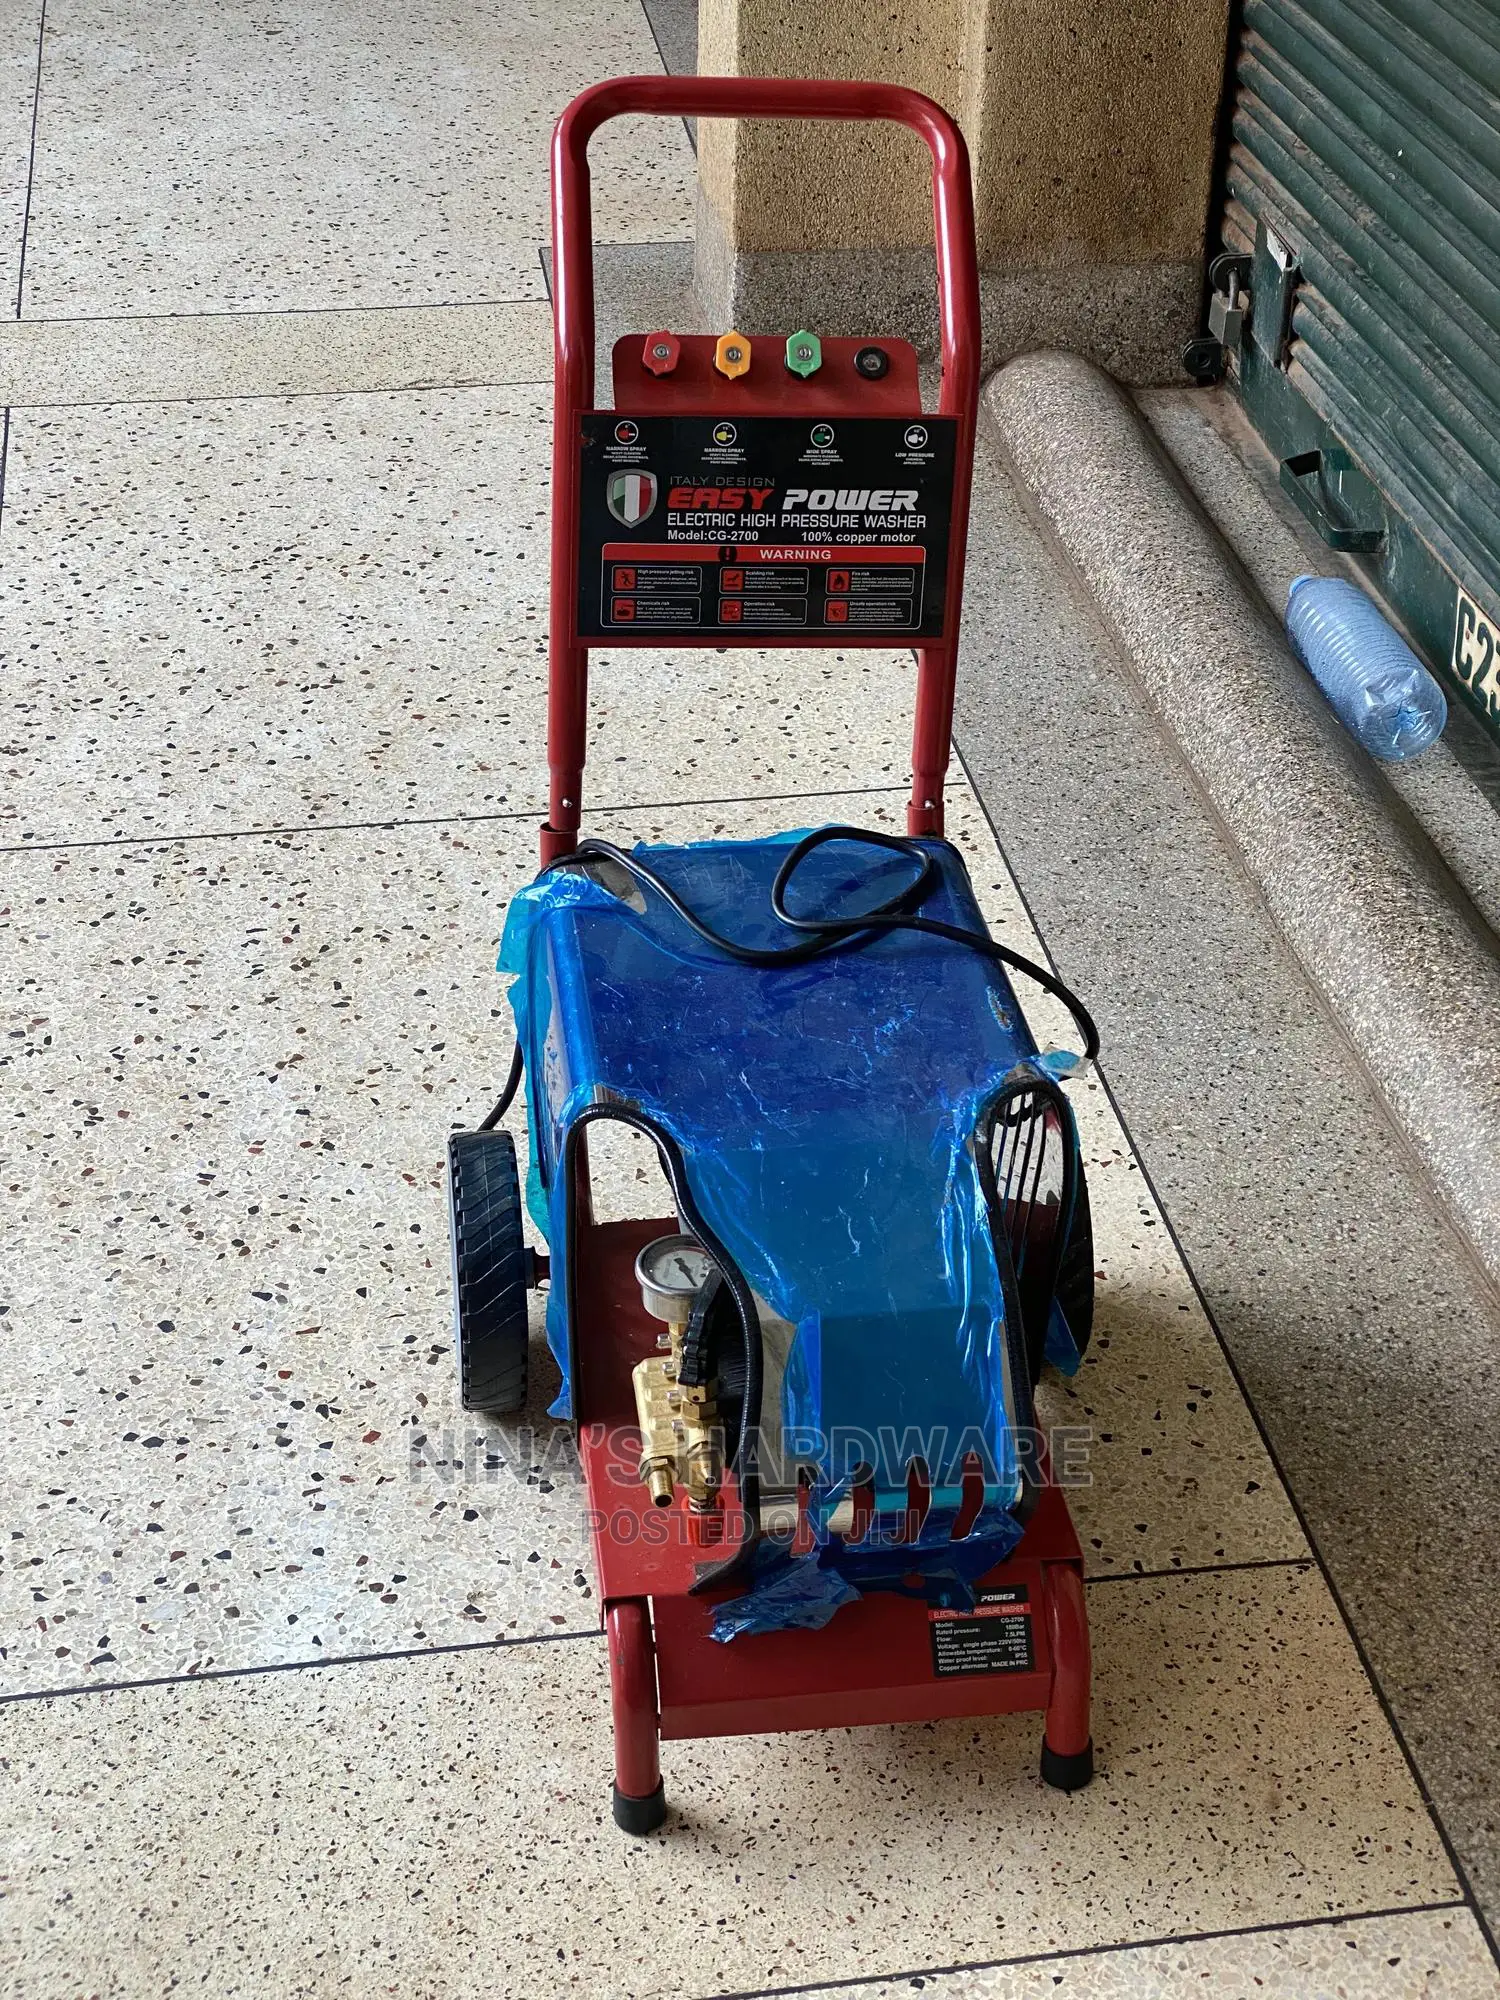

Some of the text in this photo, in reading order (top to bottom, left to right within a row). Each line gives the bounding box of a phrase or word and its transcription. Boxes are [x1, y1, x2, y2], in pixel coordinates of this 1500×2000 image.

[670, 476, 775, 486] ITALY DESIGN
[668, 488, 919, 510] EASY POWER
[668, 513, 926, 528] ELECTRIC HIGH PRESSURE WASHER
[668, 530, 758, 540] Model:CG-2700
[802, 532, 916, 544] 100% copper motor
[761, 550, 832, 560] WARNING
[981, 1593, 1015, 1602] POWER
[973, 1606, 1001, 1615] PRESSURE
[1002, 1605, 1024, 1613] WASHER
